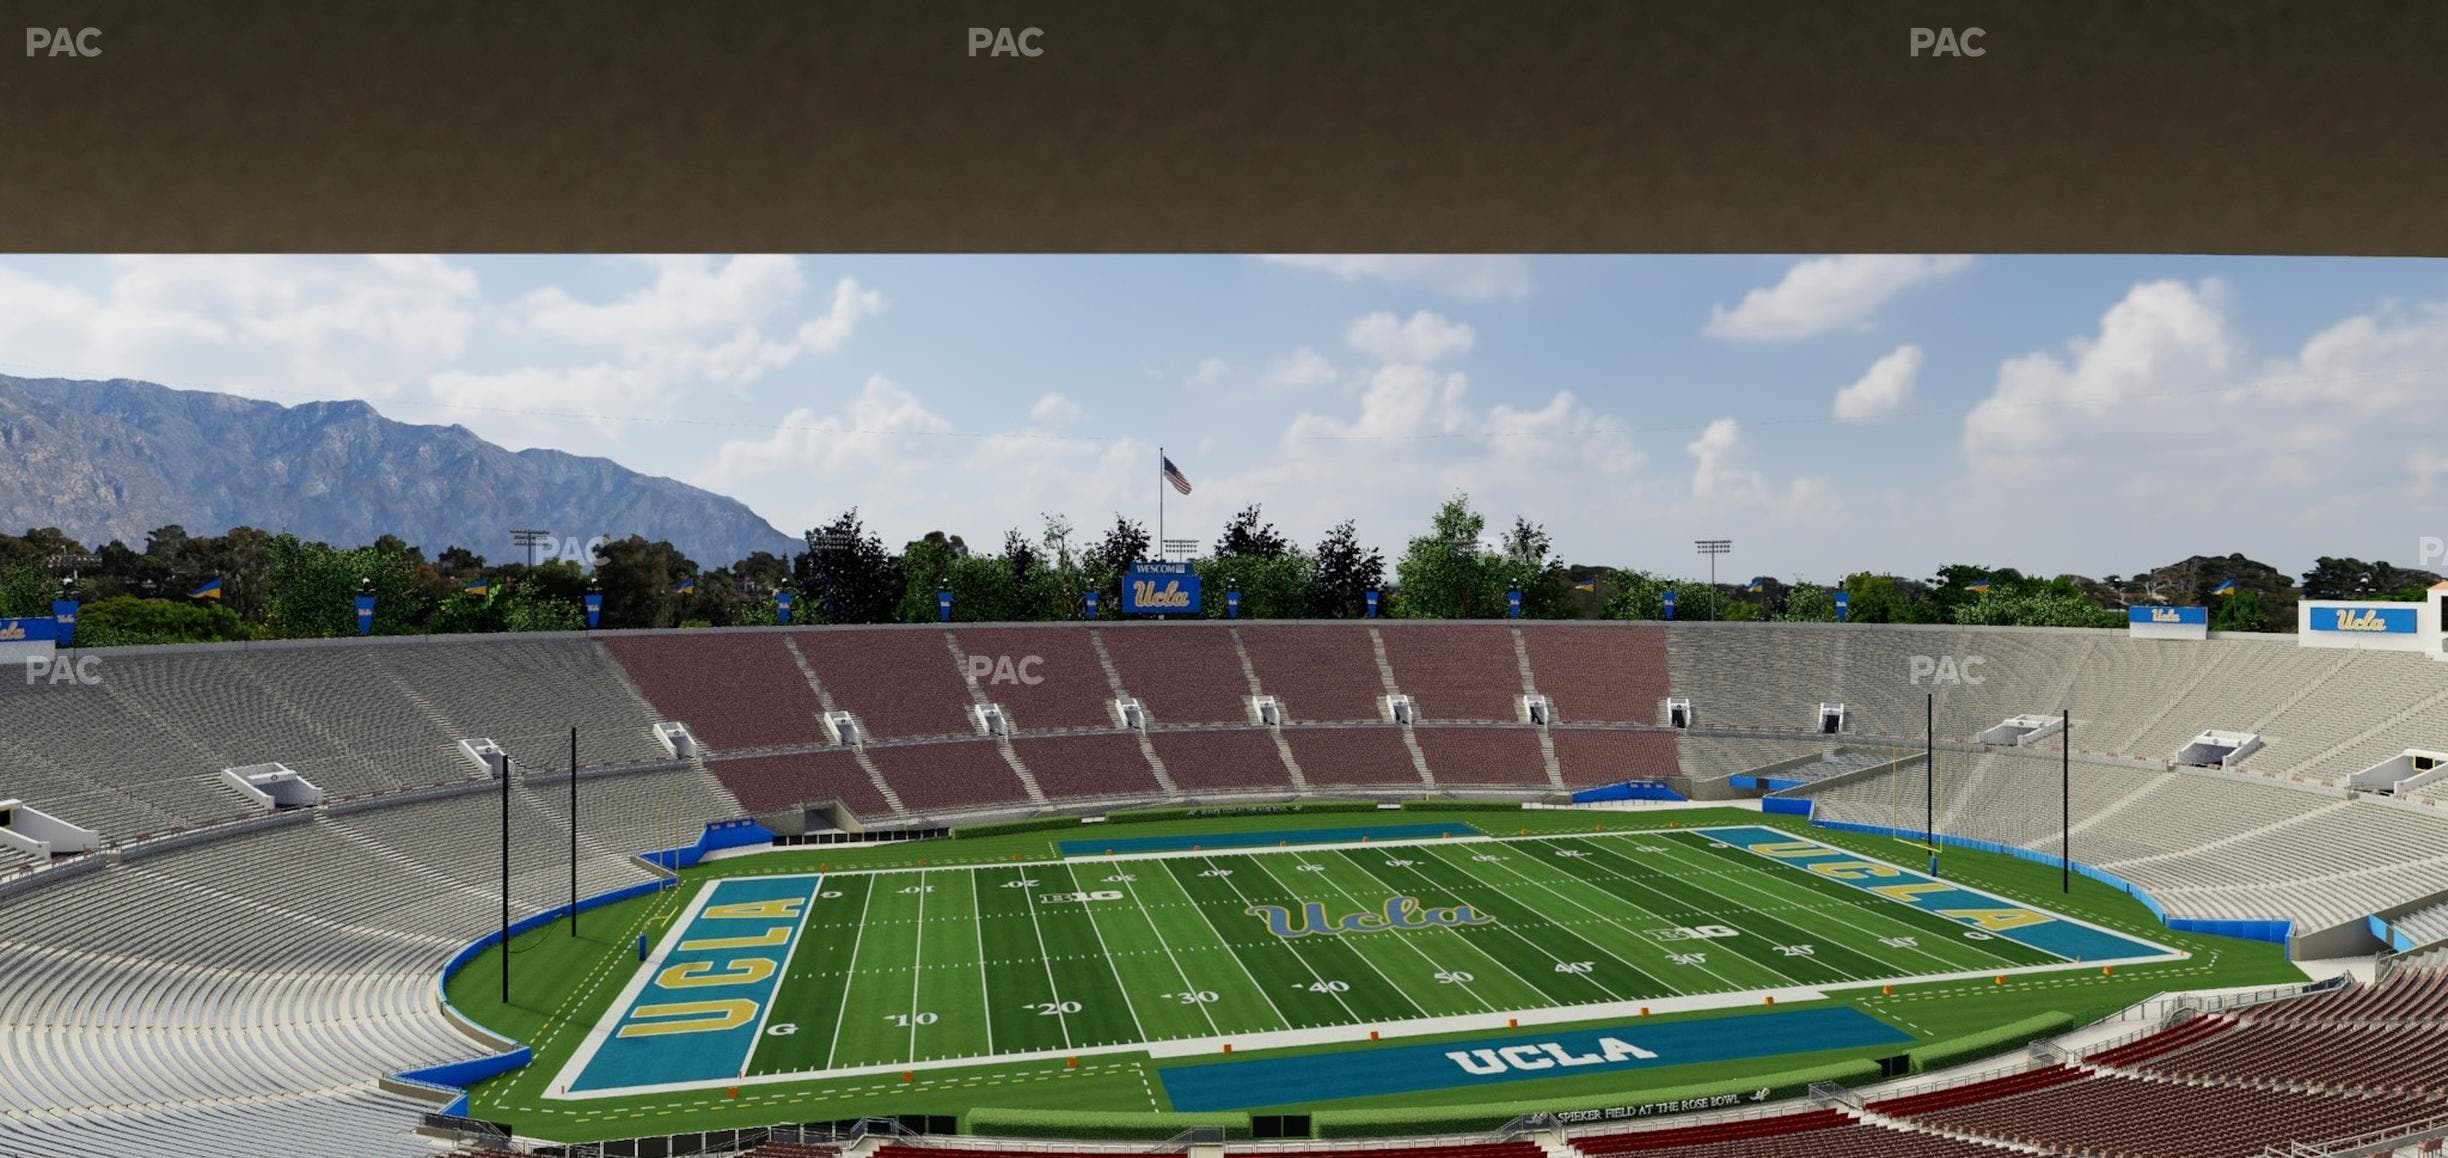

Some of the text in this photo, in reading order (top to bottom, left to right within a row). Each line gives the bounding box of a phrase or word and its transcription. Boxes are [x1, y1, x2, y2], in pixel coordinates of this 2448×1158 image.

[1136, 564, 1175, 573] WESCOM
[1133, 580, 1190, 607] Ucla
[2152, 608, 2180, 622] Ucla
[2336, 609, 2387, 631] Ucla
[0, 621, 26, 640] cla
[1748, 841, 2057, 931] UCLA
[1244, 896, 1496, 937] Ucla
[616, 897, 806, 1039] UCLA
[1554, 961, 1592, 974] 40
[1434, 971, 1474, 984] 50
[1308, 980, 1350, 993] 40
[1177, 991, 1219, 1004] 30
[1037, 1001, 1082, 1015] 20
[895, 1012, 938, 1027] 10
[767, 1023, 799, 1036] G
[1445, 1037, 1659, 1075] UCLA
[1558, 1093, 1741, 1124] SPIEKER FIELD AT THE ROSE BOWL
